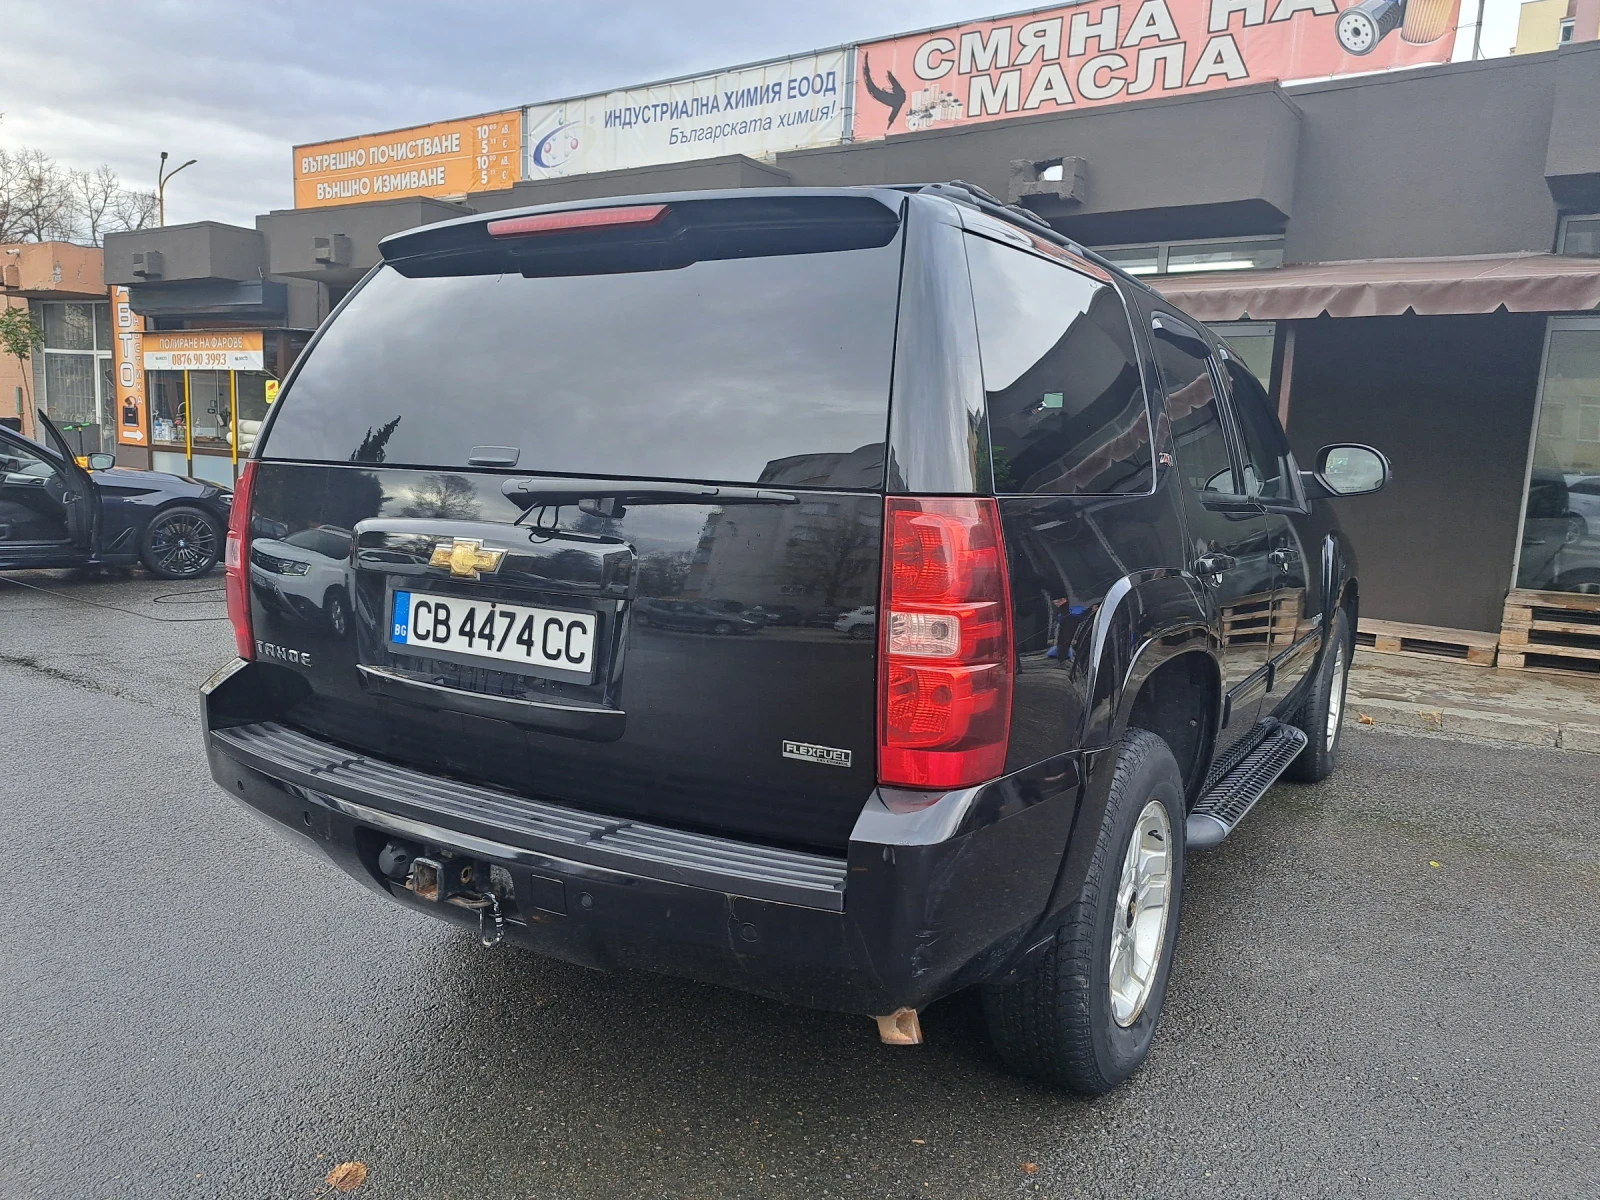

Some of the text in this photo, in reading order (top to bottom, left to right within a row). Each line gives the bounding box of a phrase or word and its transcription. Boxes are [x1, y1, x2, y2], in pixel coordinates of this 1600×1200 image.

[912, 0, 1181, 81] СМЯНА
[967, 33, 1250, 117] МАСЛА
[604, 71, 836, 129] ИНДУСТРИАЛНА ХИМИЯ ЕООД
[669, 100, 836, 145] Българската химия!
[302, 133, 460, 174] ВЪТРЕШНО ПОЧИСТВАНЕ
[316, 166, 445, 200] ВЪНШНО ИЗМИВАНЕ
[159, 336, 243, 349] ПОЛИРАНЕ НА ФАРОВЕ
[171, 353, 192, 365] 0876
[193, 353, 203, 365] 90
[204, 352, 227, 365] 3993
[394, 624, 407, 637] BG
[255, 639, 313, 667] TAHOE
[786, 744, 848, 761] FLEXFUEL
